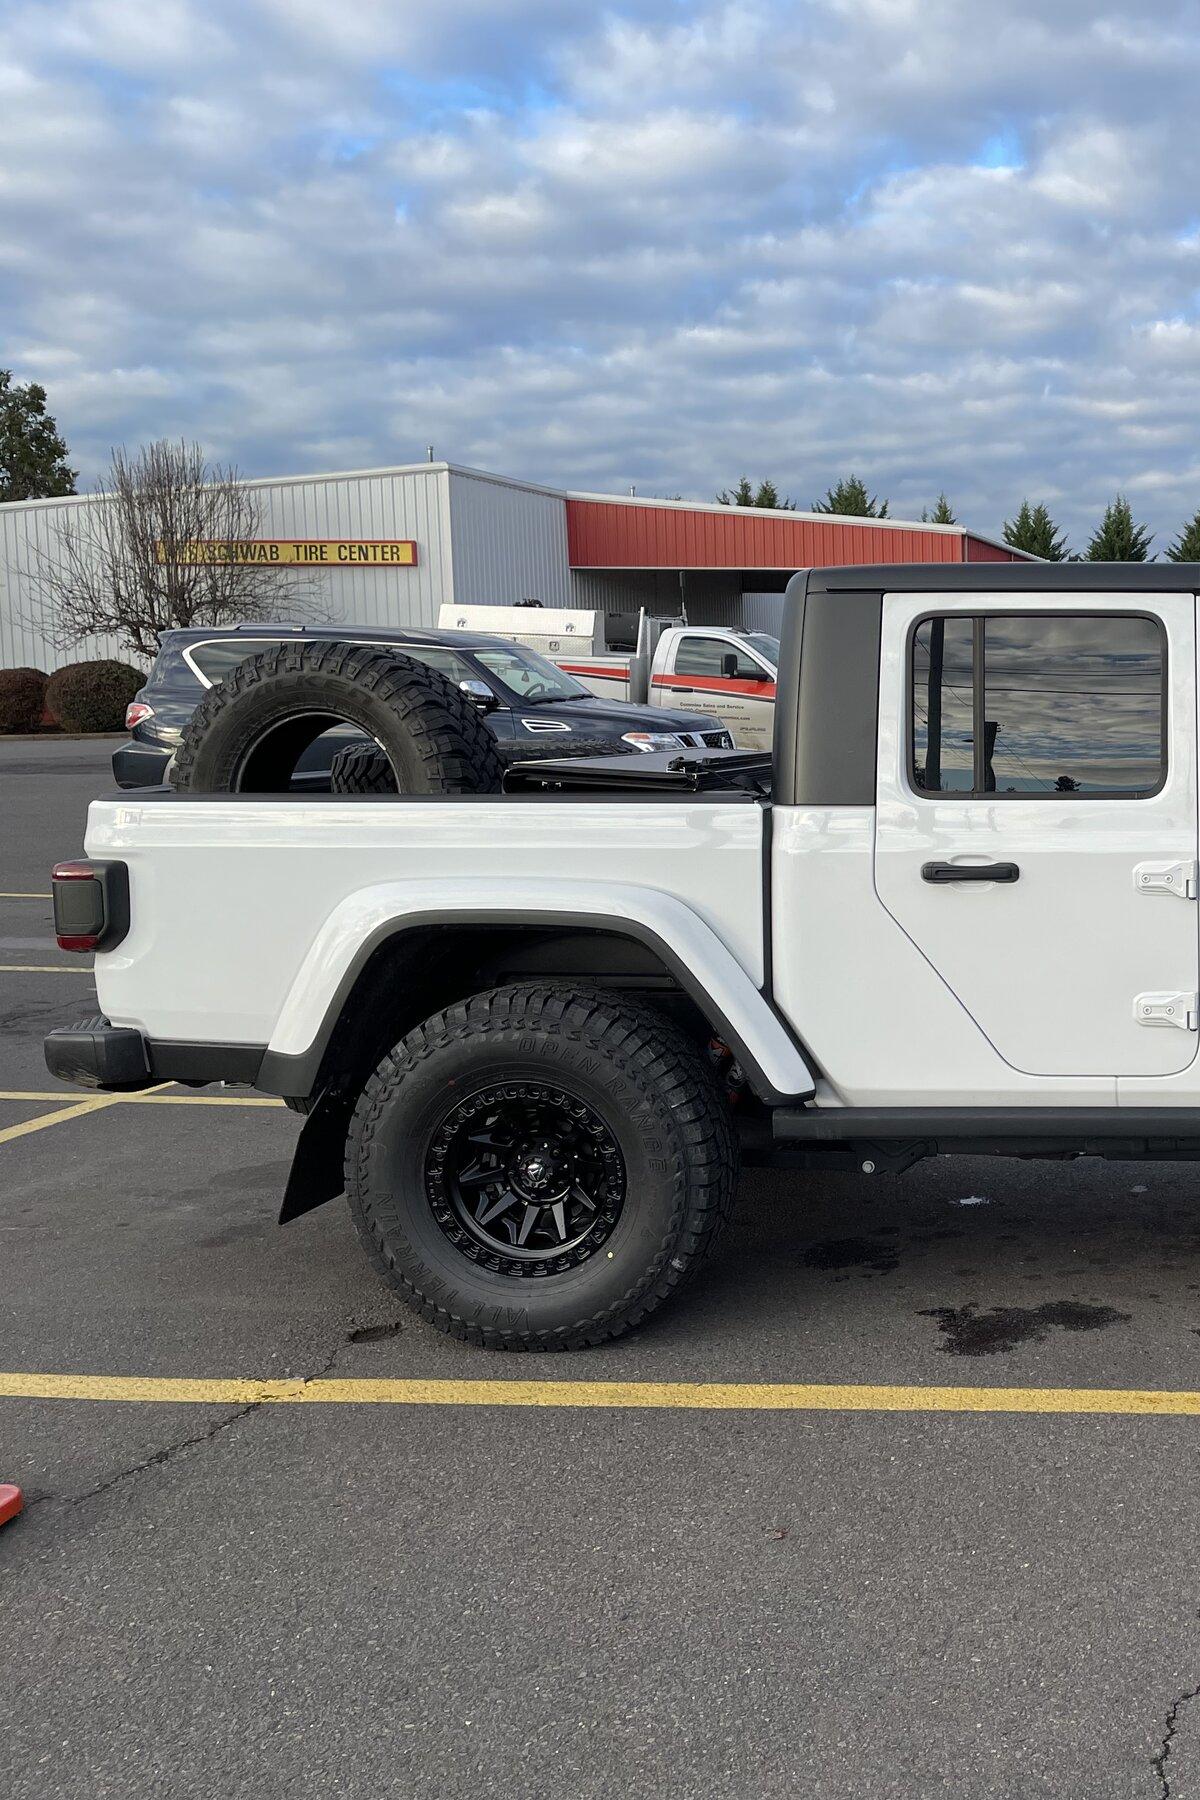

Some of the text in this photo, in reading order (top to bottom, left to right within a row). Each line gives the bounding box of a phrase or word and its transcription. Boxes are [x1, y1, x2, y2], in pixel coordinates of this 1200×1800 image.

[292, 544, 328, 561] TIRE
[338, 545, 401, 561] CENTER
[518, 1036, 668, 1172] OPEN RANGE
